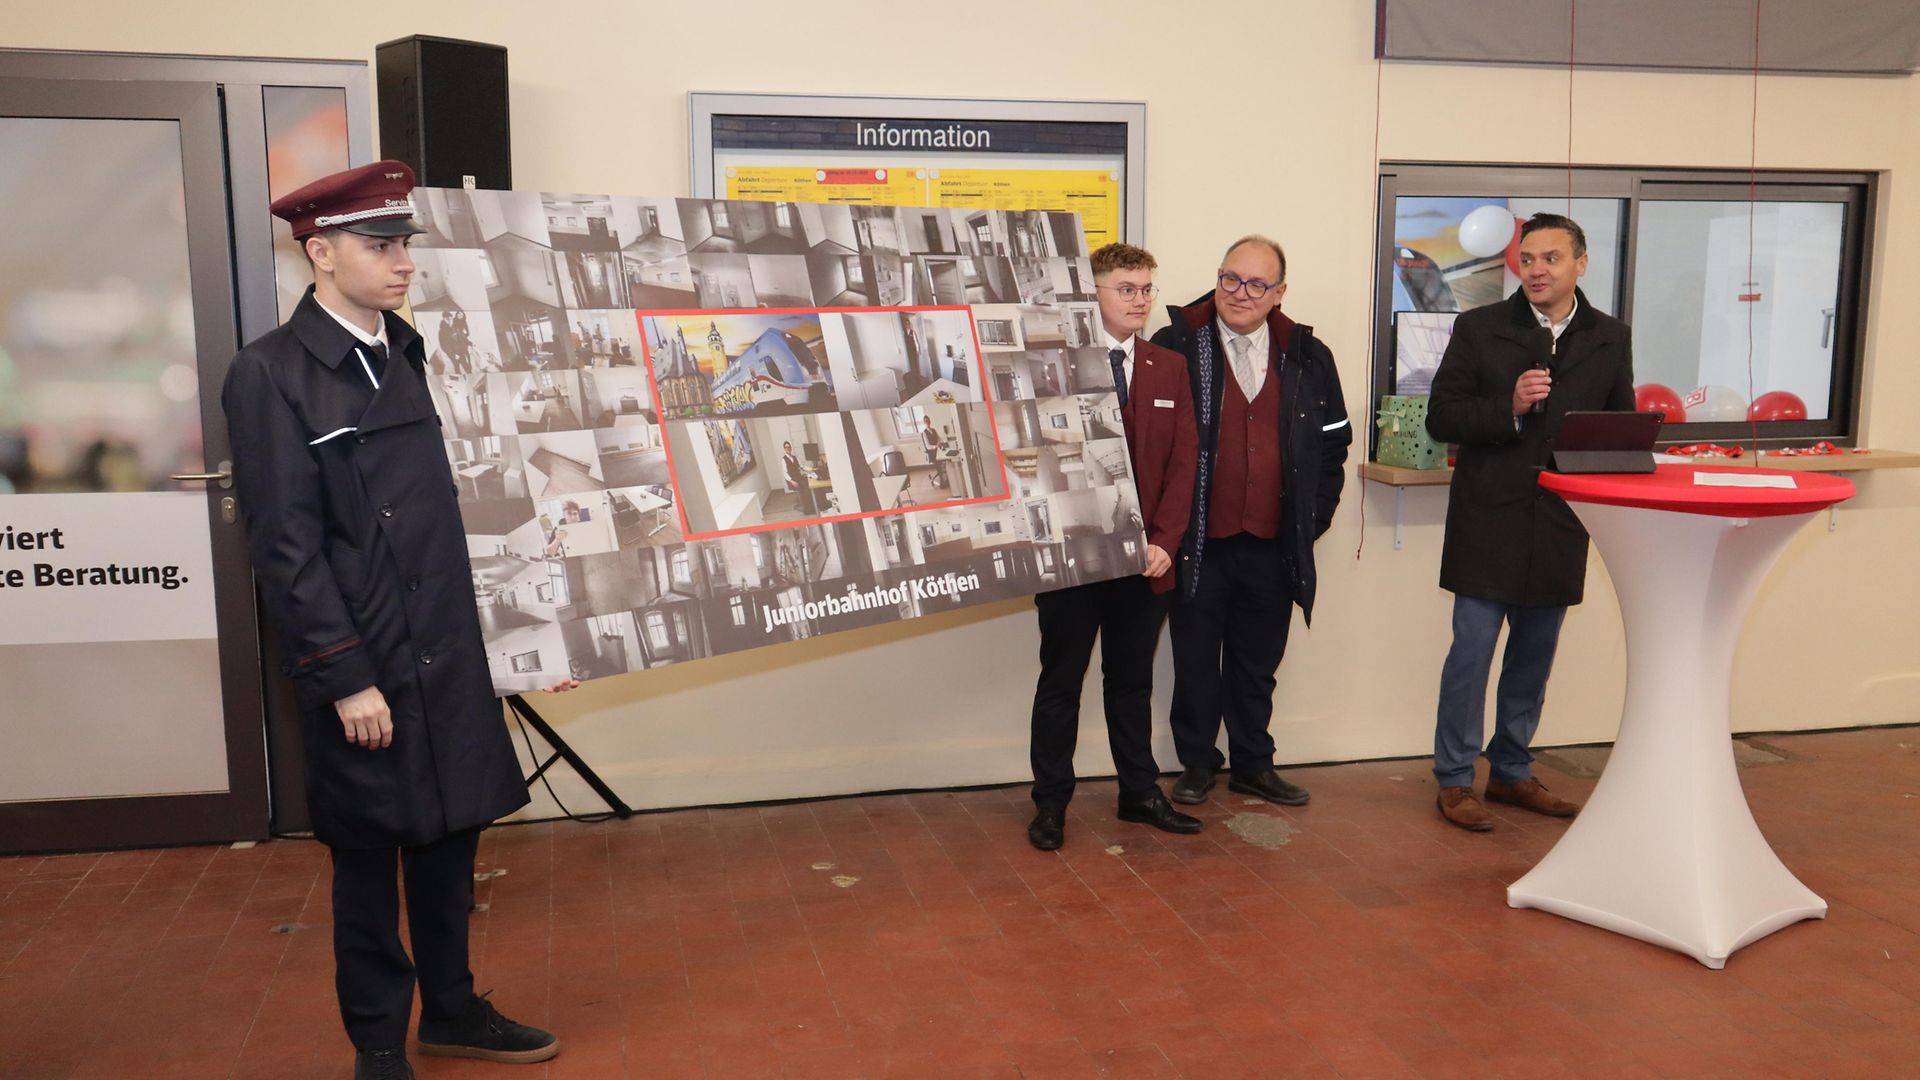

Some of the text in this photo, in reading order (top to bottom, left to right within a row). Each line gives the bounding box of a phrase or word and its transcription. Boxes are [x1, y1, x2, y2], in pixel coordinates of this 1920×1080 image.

[856, 122, 990, 148] Information
[0, 525, 65, 550] iert
[33, 563, 188, 590] Beratung.
[763, 573, 980, 633] Juniorbahnhof Köthen
